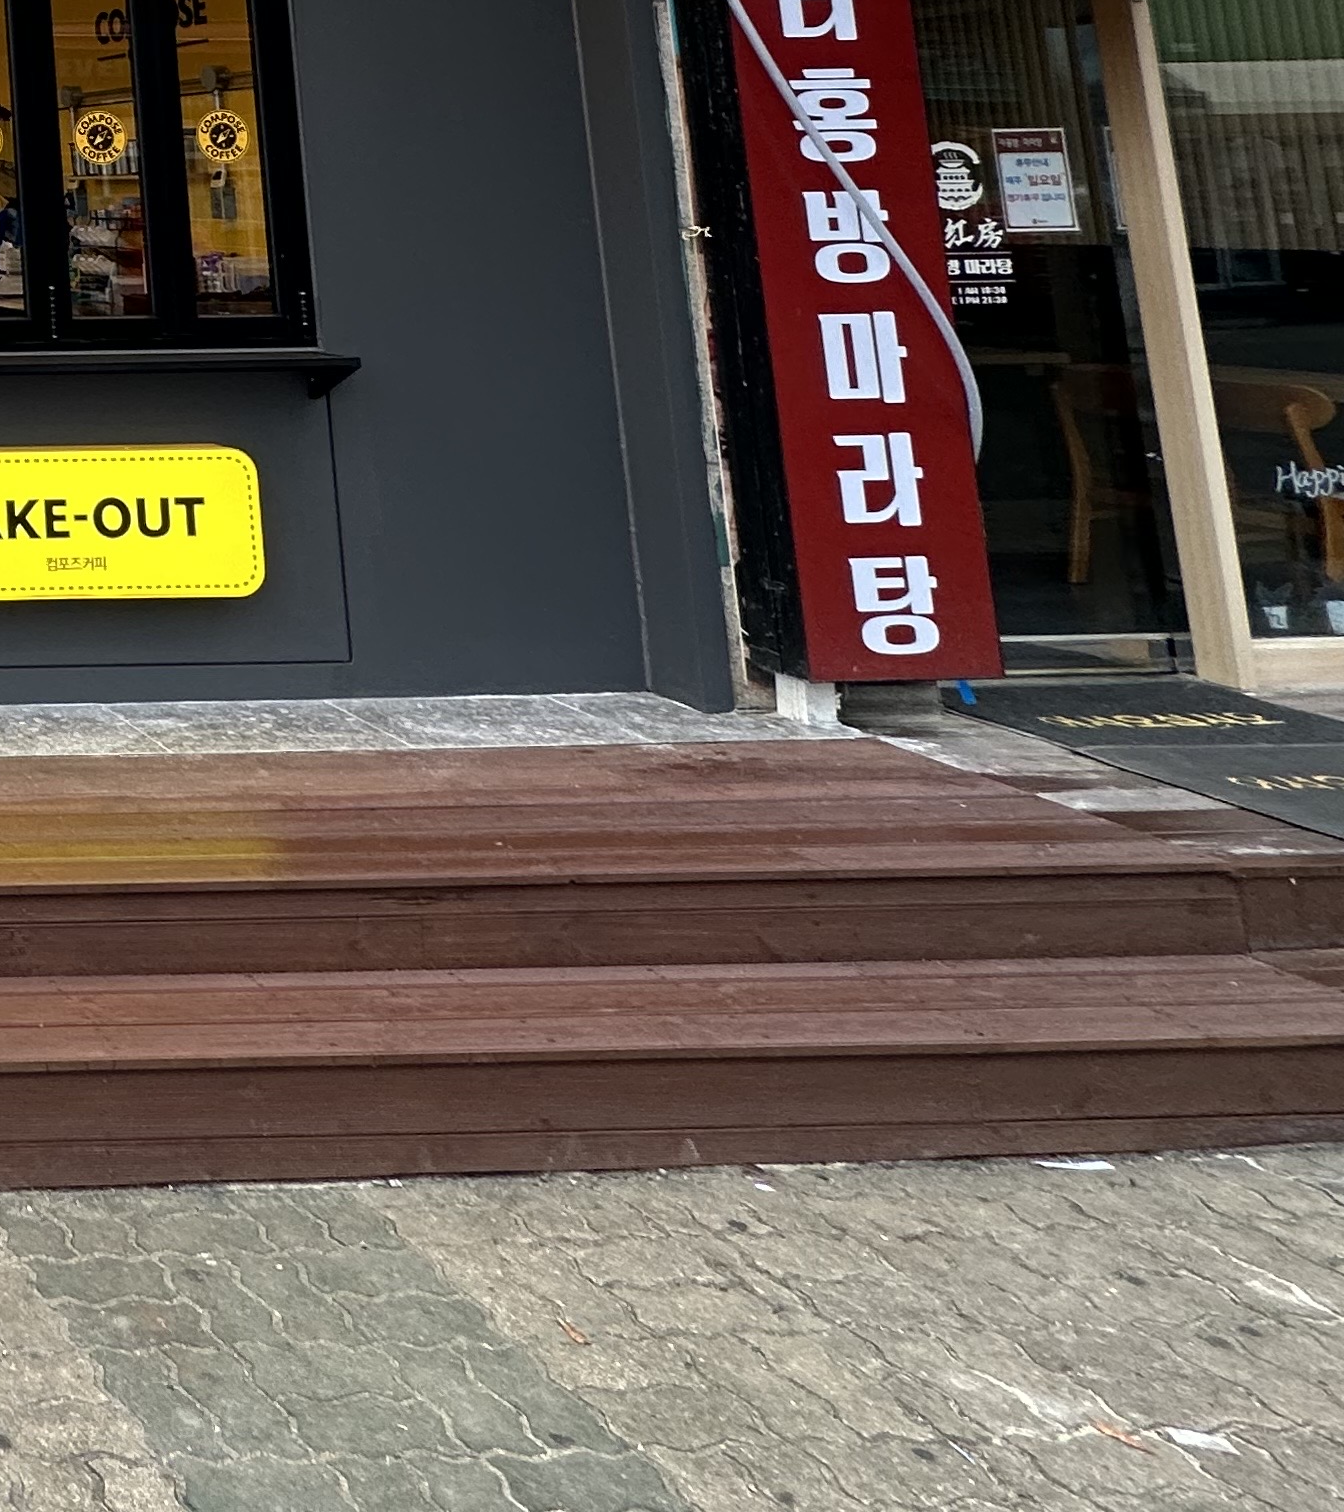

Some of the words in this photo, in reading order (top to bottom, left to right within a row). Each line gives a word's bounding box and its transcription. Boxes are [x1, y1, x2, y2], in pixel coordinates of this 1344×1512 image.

[76, 113, 123, 137] COMPOSE
[199, 112, 246, 135] COMPOSE
[81, 145, 122, 162] COFFEE
[203, 144, 244, 161] COFFEE
[45, 556, 108, 572] 컴포즈커피
